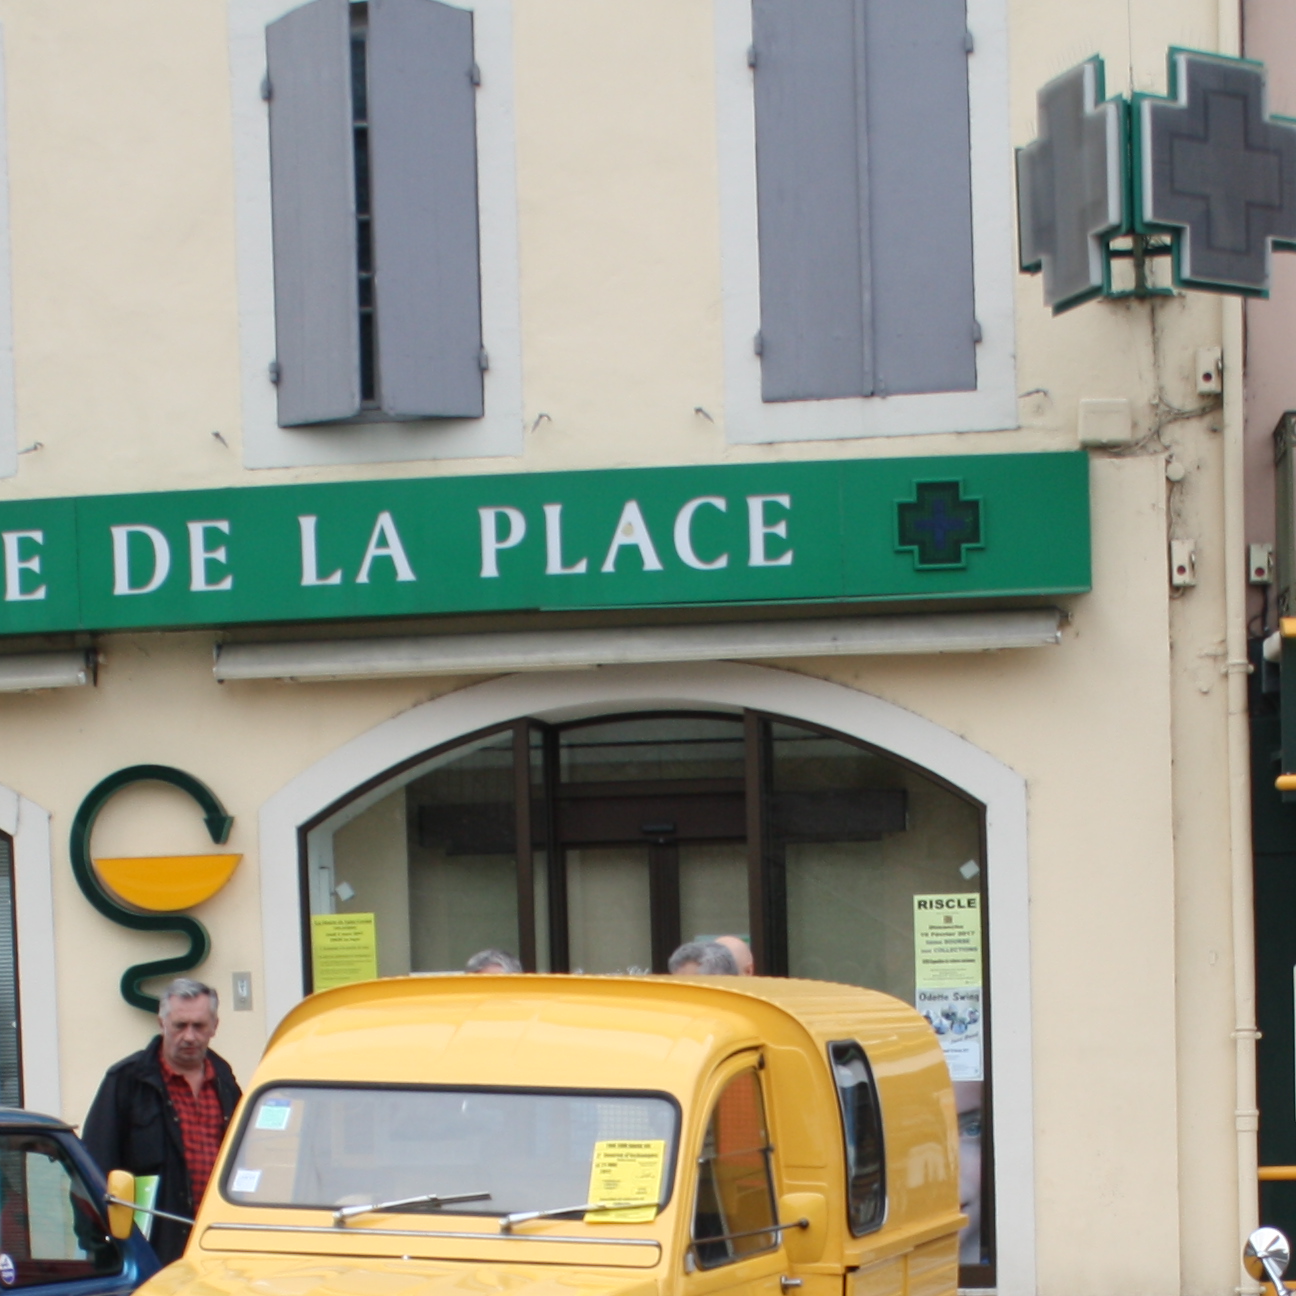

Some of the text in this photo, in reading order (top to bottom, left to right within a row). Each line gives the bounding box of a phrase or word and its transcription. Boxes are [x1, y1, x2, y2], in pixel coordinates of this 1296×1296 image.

[110, 519, 233, 596] DE
[298, 510, 417, 586] LA
[478, 494, 794, 579] PLACE
[917, 898, 977, 910] RISCLE
[919, 992, 980, 1002] Odette Swing
